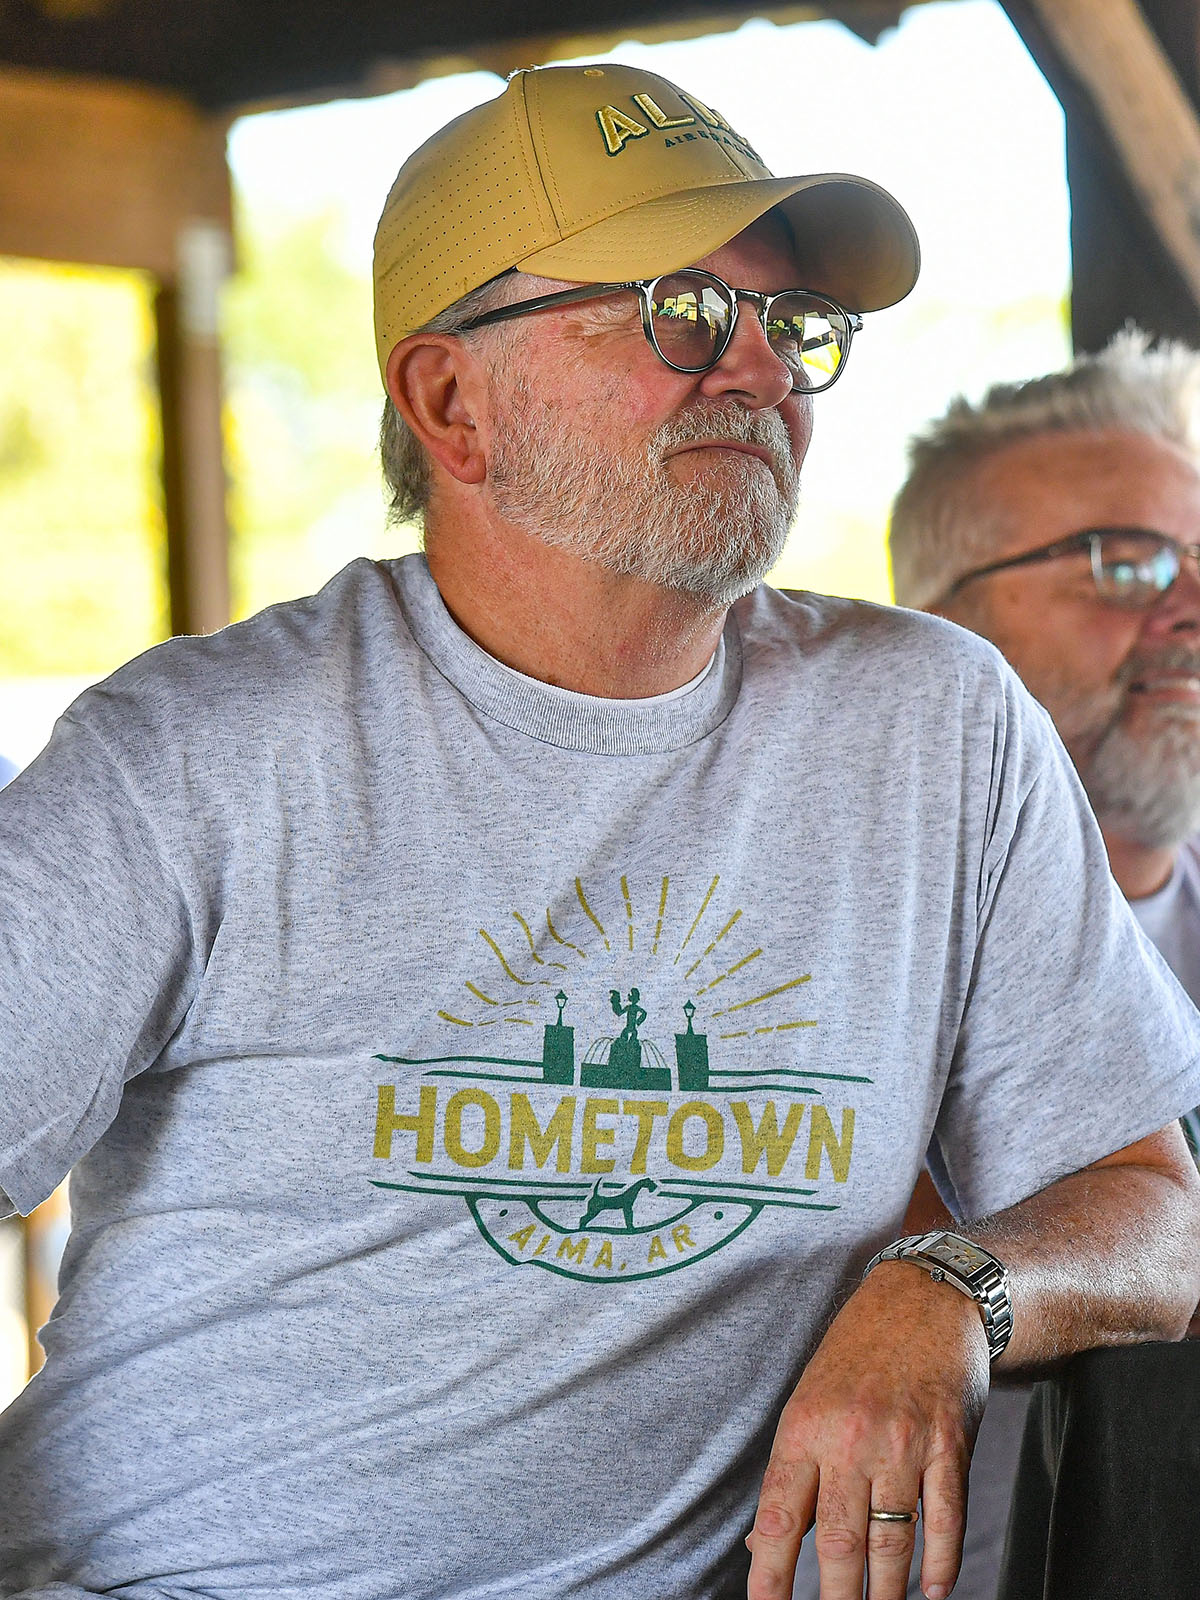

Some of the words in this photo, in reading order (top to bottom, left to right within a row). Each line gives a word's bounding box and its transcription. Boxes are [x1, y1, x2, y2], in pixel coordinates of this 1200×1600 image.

[595, 92, 749, 157] AL
[373, 1084, 856, 1183] HOMETOWN
[507, 1223, 627, 1271] ALMA,
[647, 1223, 697, 1264] AR
